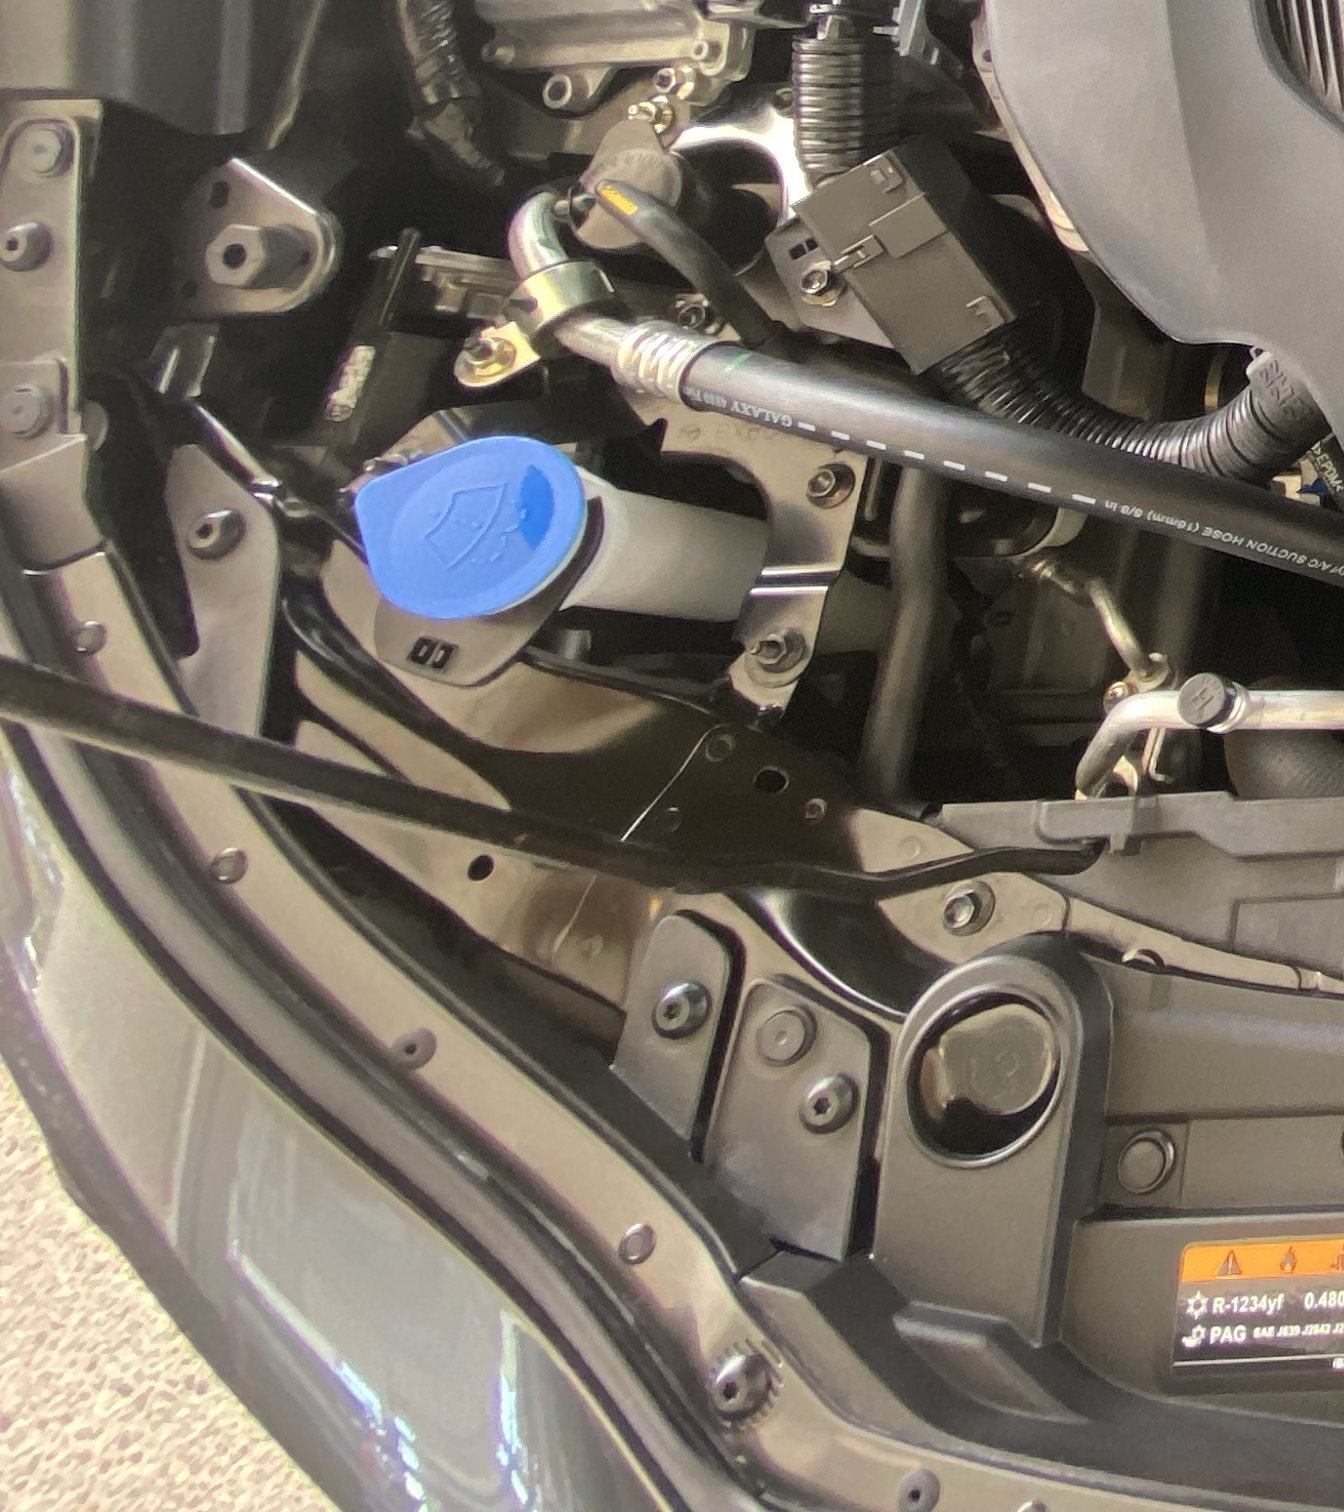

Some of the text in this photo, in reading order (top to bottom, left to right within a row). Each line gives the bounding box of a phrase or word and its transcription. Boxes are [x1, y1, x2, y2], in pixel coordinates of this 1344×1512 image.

[731, 399, 793, 428] GALAXY
[1147, 509, 1200, 534] (16mm)
[1203, 525, 1245, 546] HOSE
[1248, 539, 1307, 563] SUCTION
[1307, 555, 1331, 571] A/C
[1212, 1294, 1284, 1315] R-1234yf
[1209, 1326, 1246, 1344] PAG
[1252, 1326, 1275, 1339] SAE
